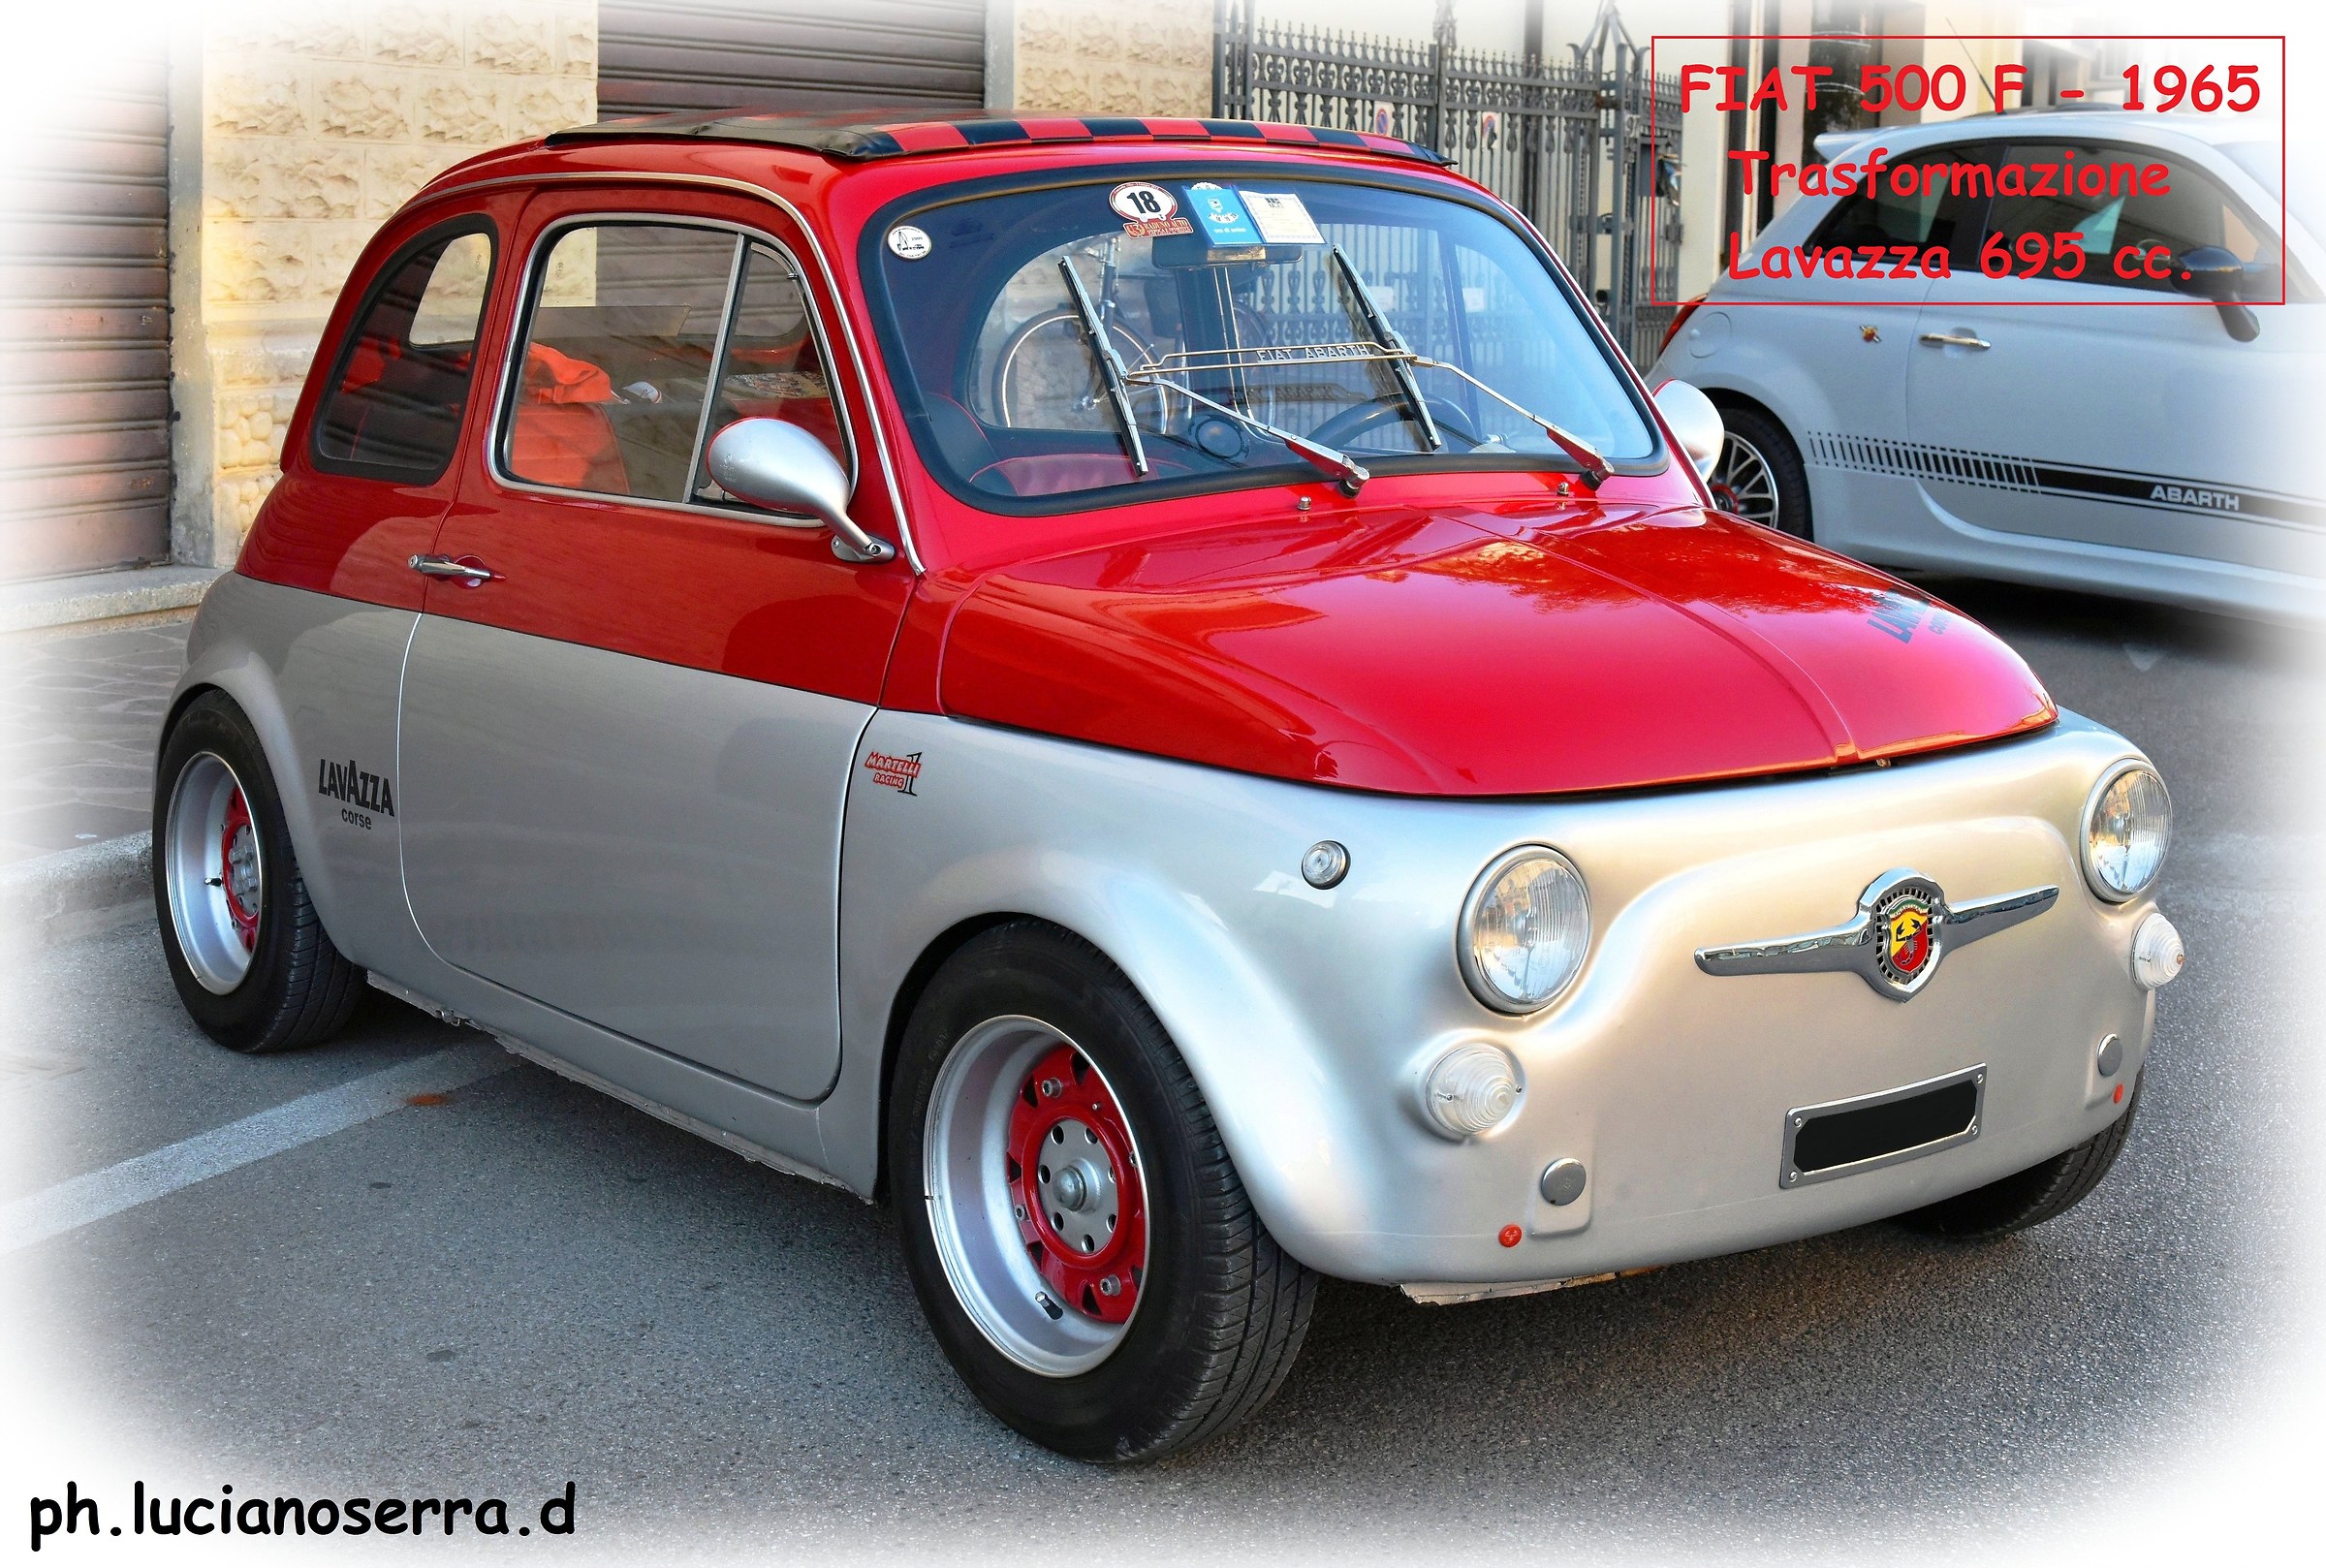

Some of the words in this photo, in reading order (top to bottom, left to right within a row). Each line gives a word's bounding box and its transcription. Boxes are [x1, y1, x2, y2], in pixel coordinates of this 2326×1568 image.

[1126, 190, 1162, 214] 18
[1255, 348, 1293, 361] FIAT
[1304, 344, 1371, 360] ABARTH
[2150, 485, 2240, 511] ABARTH
[865, 752, 922, 778] MARTELLI
[318, 758, 395, 818] LAVAZZA
[873, 773, 904, 789] RACING
[341, 808, 372, 831] corse
